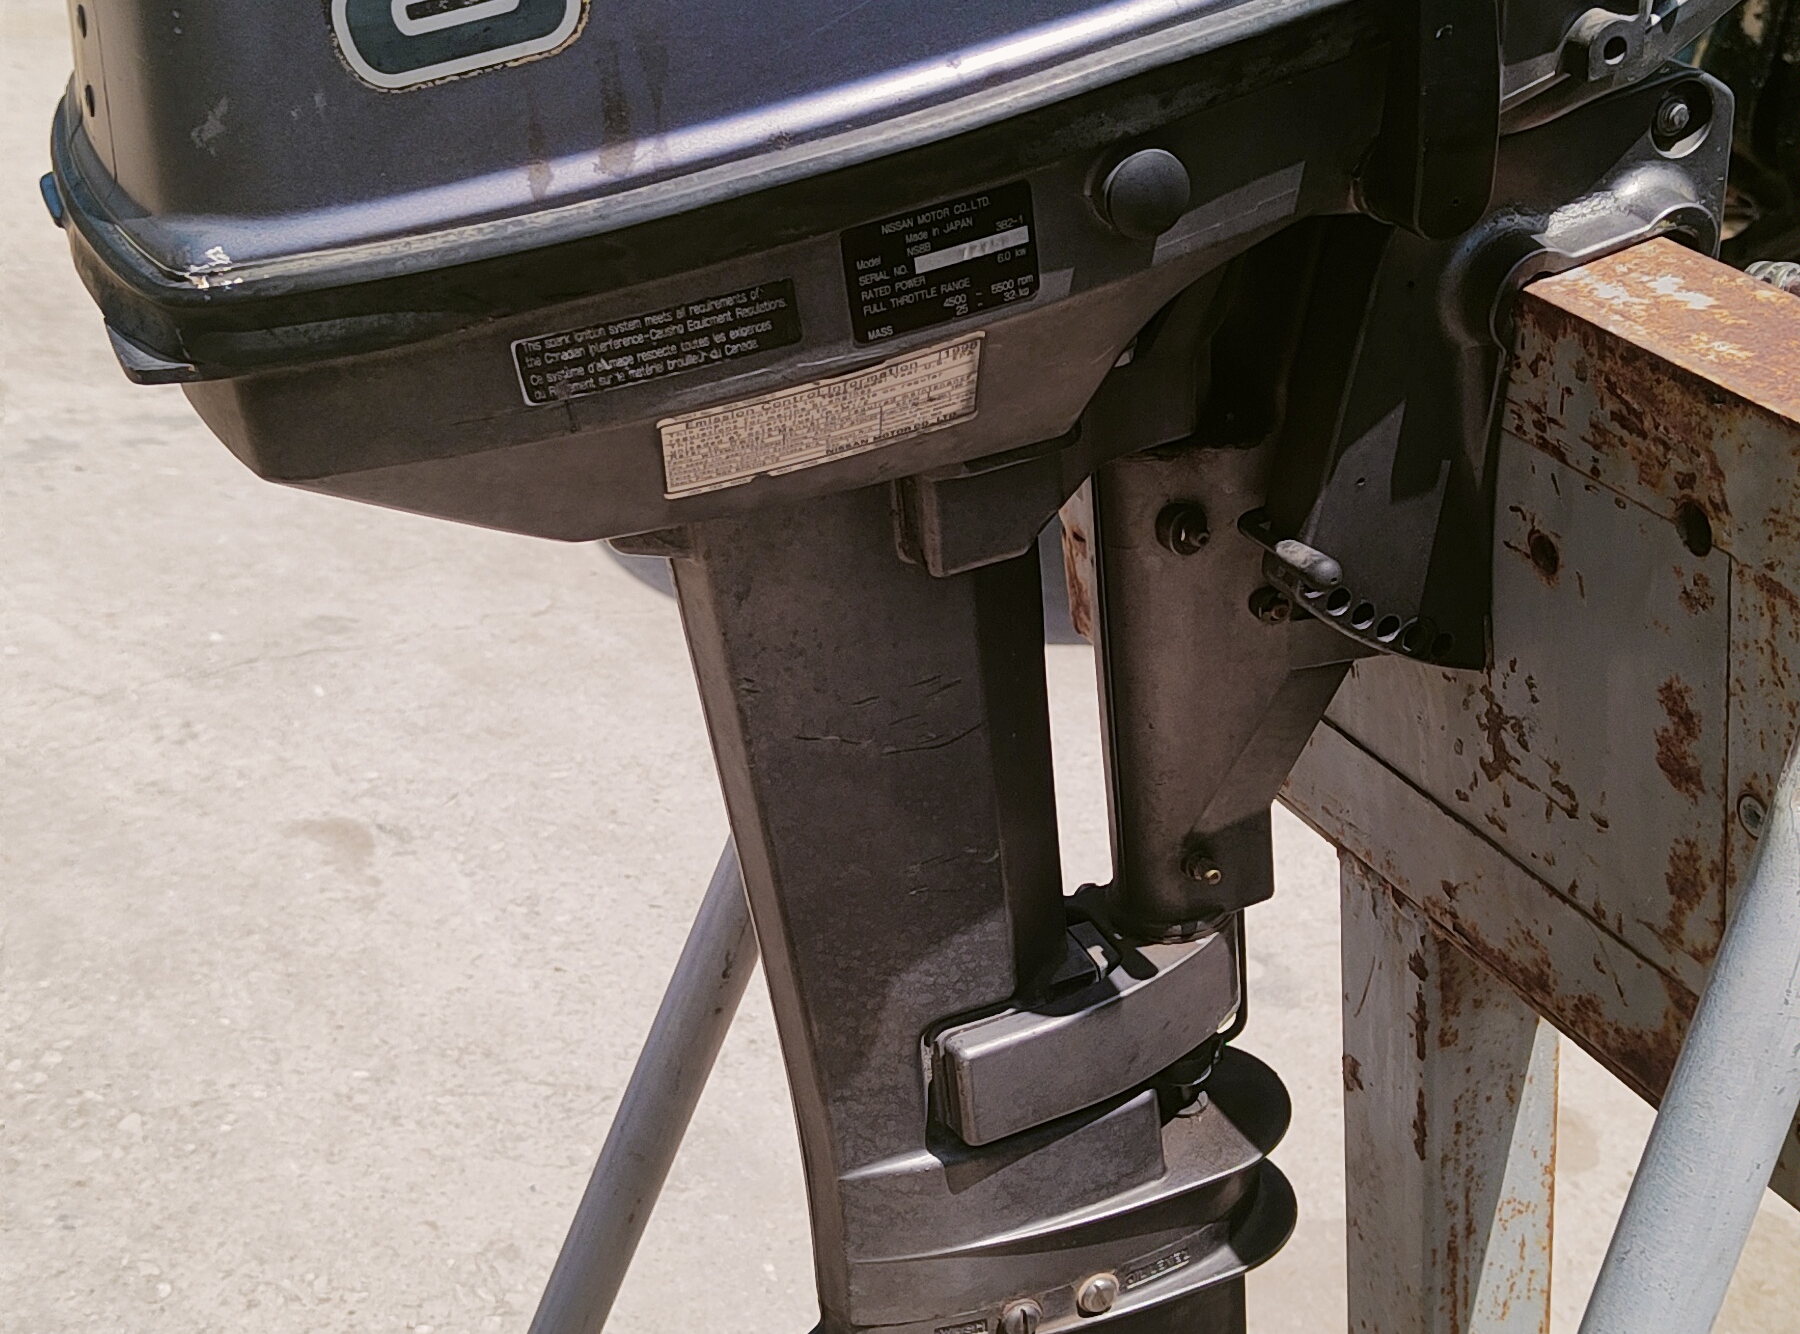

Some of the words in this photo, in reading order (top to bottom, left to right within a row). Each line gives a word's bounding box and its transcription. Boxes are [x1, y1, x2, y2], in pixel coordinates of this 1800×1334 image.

[881, 218, 914, 235] NISSAN
[917, 207, 950, 225] MOTOR
[905, 231, 928, 244] Made
[932, 227, 940, 236] in
[943, 217, 973, 233] JAPAN
[856, 256, 881, 270] Model
[858, 270, 890, 286] SERIAL
[861, 285, 891, 301] RATED
[895, 275, 926, 292] POWER
[863, 302, 887, 317] FULL
[889, 286, 938, 308] THROTTLE
[940, 277, 971, 294] RANGE
[943, 293, 967, 307] 4500
[991, 279, 1014, 294] 5500
[608, 319, 642, 335] system
[644, 312, 673, 326] meets
[688, 293, 747, 316] requirements
[686, 310, 734, 331] Equipment
[868, 325, 893, 340] MASS
[956, 303, 968, 316] 25
[1003, 290, 1016, 301] 32
[636, 344, 677, 362] respecte
[685, 404, 755, 430] Emission
[761, 388, 821, 412] Control
[827, 361, 919, 396] Information
